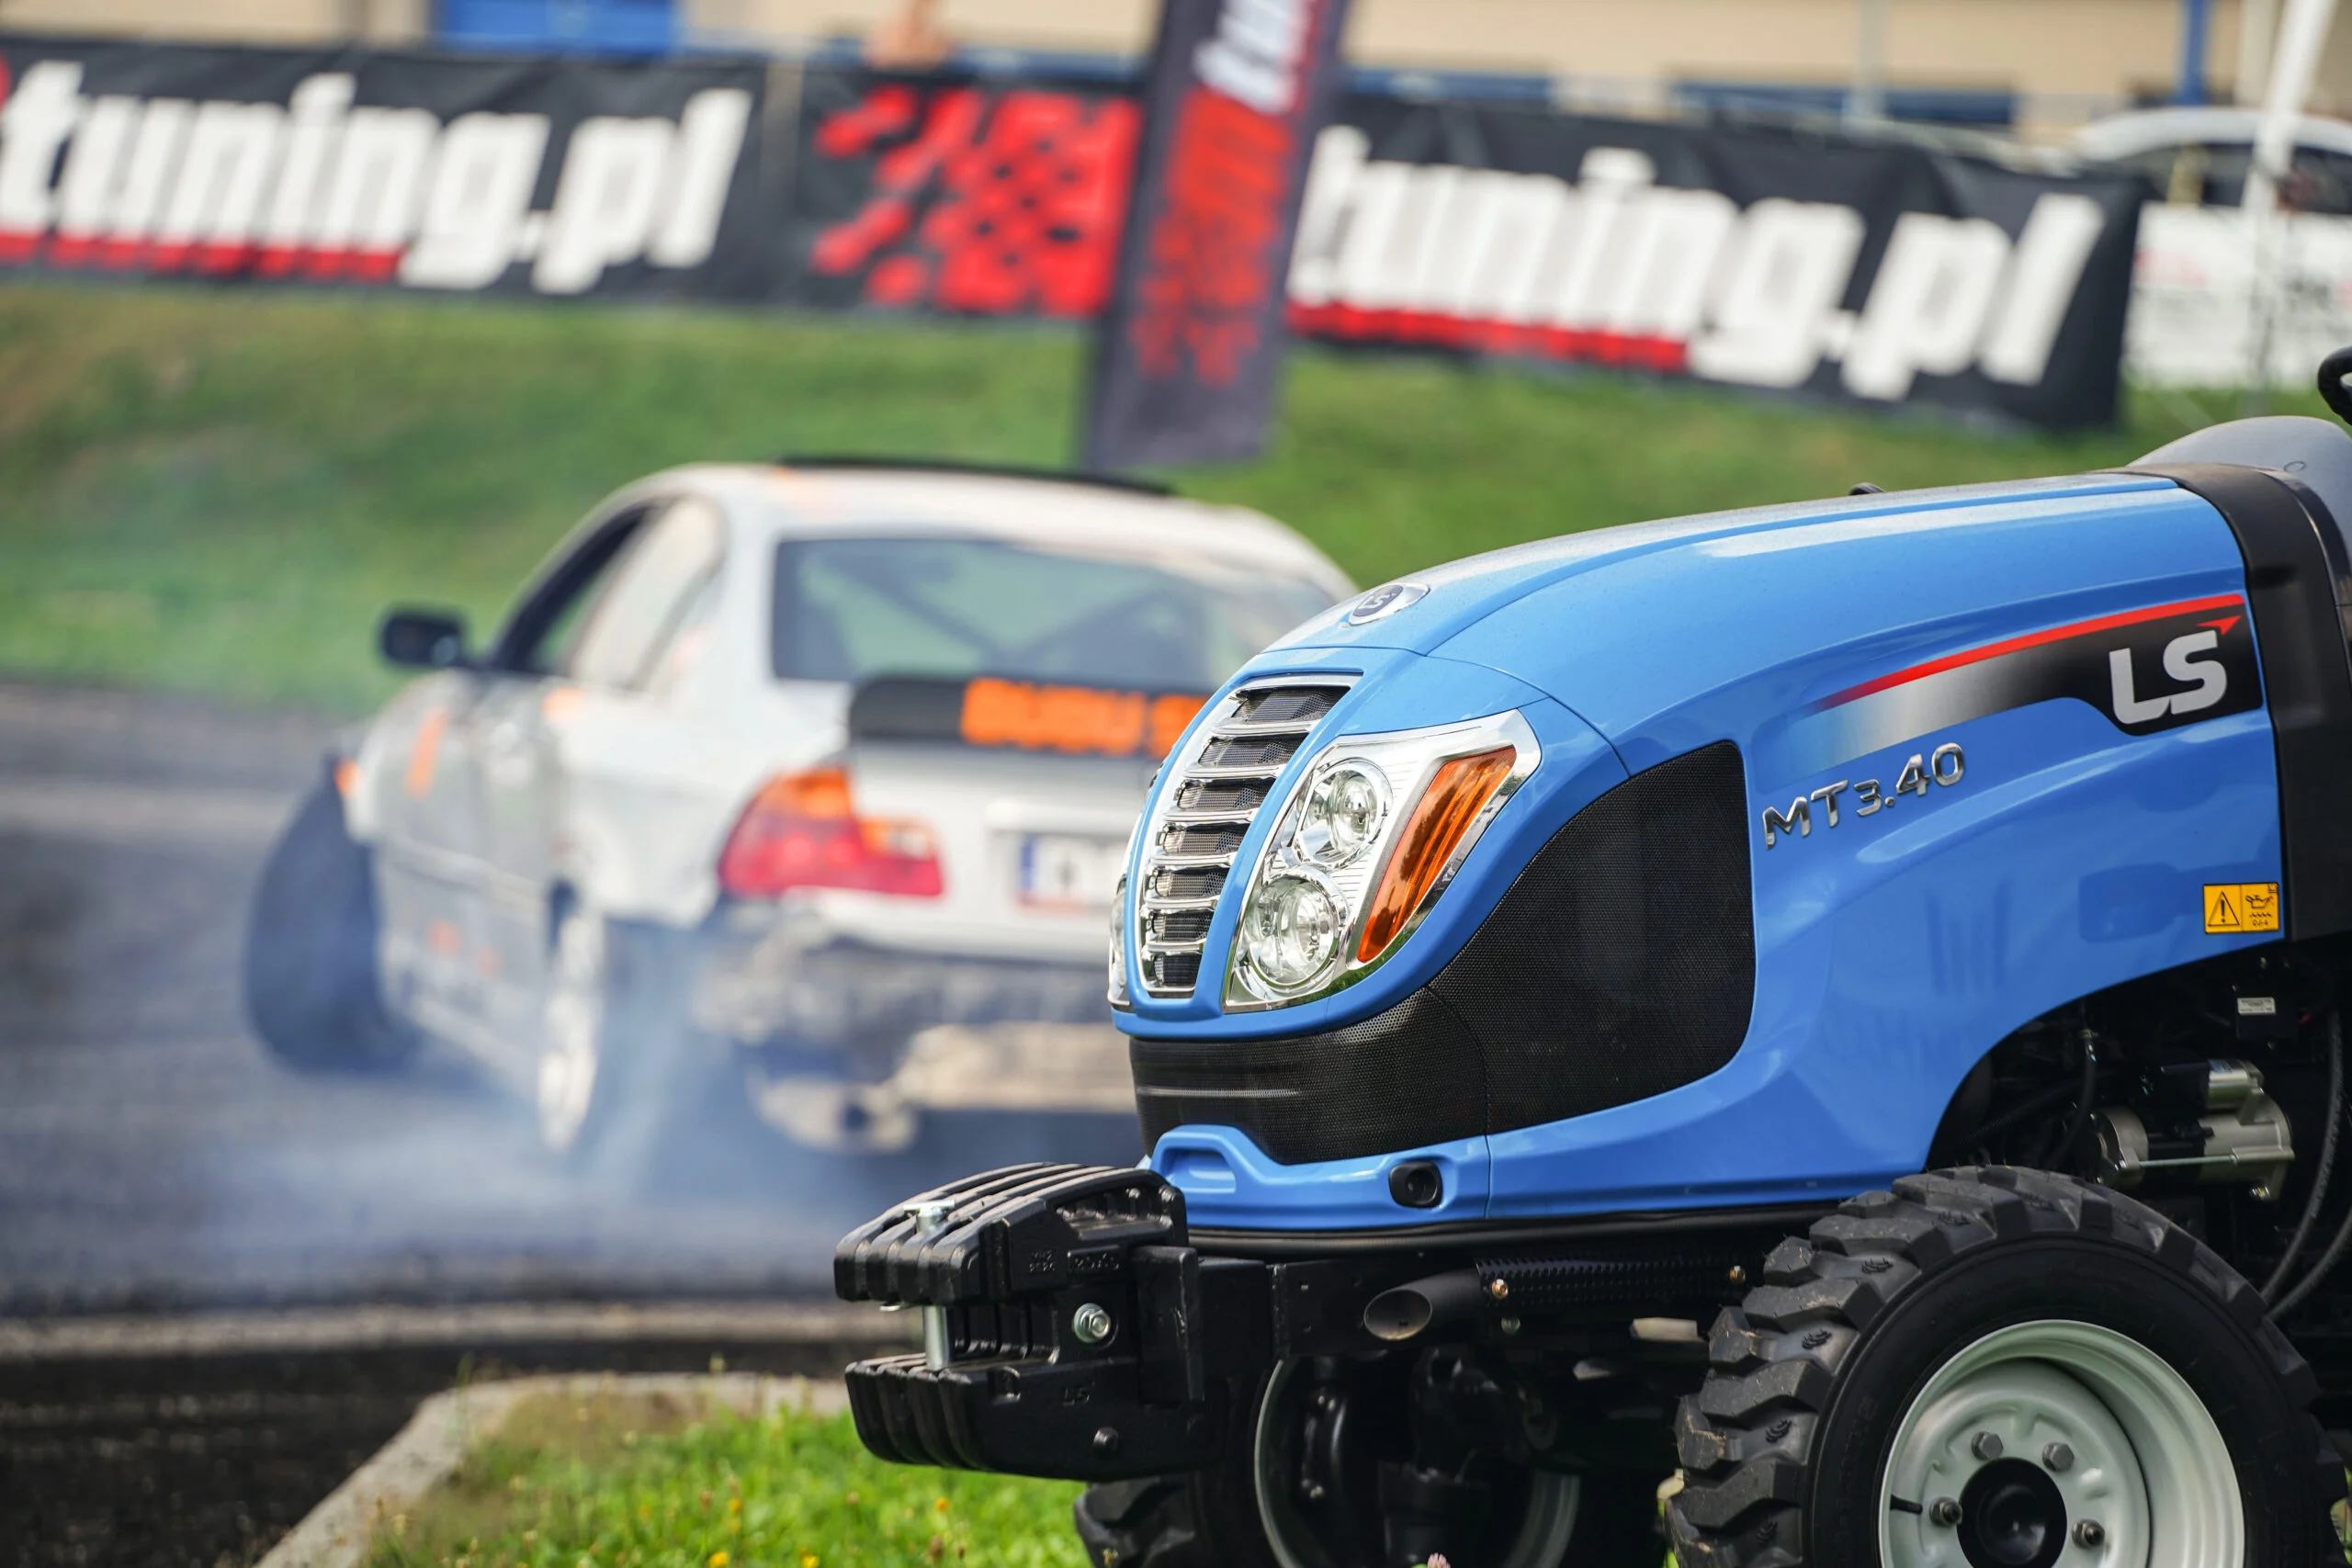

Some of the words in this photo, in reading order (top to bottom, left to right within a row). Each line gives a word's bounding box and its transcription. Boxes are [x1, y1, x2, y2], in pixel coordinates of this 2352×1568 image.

[0, 59, 753, 295] tuning.pl
[1287, 123, 2105, 401] tuning.pl
[2109, 629, 2228, 726] LS
